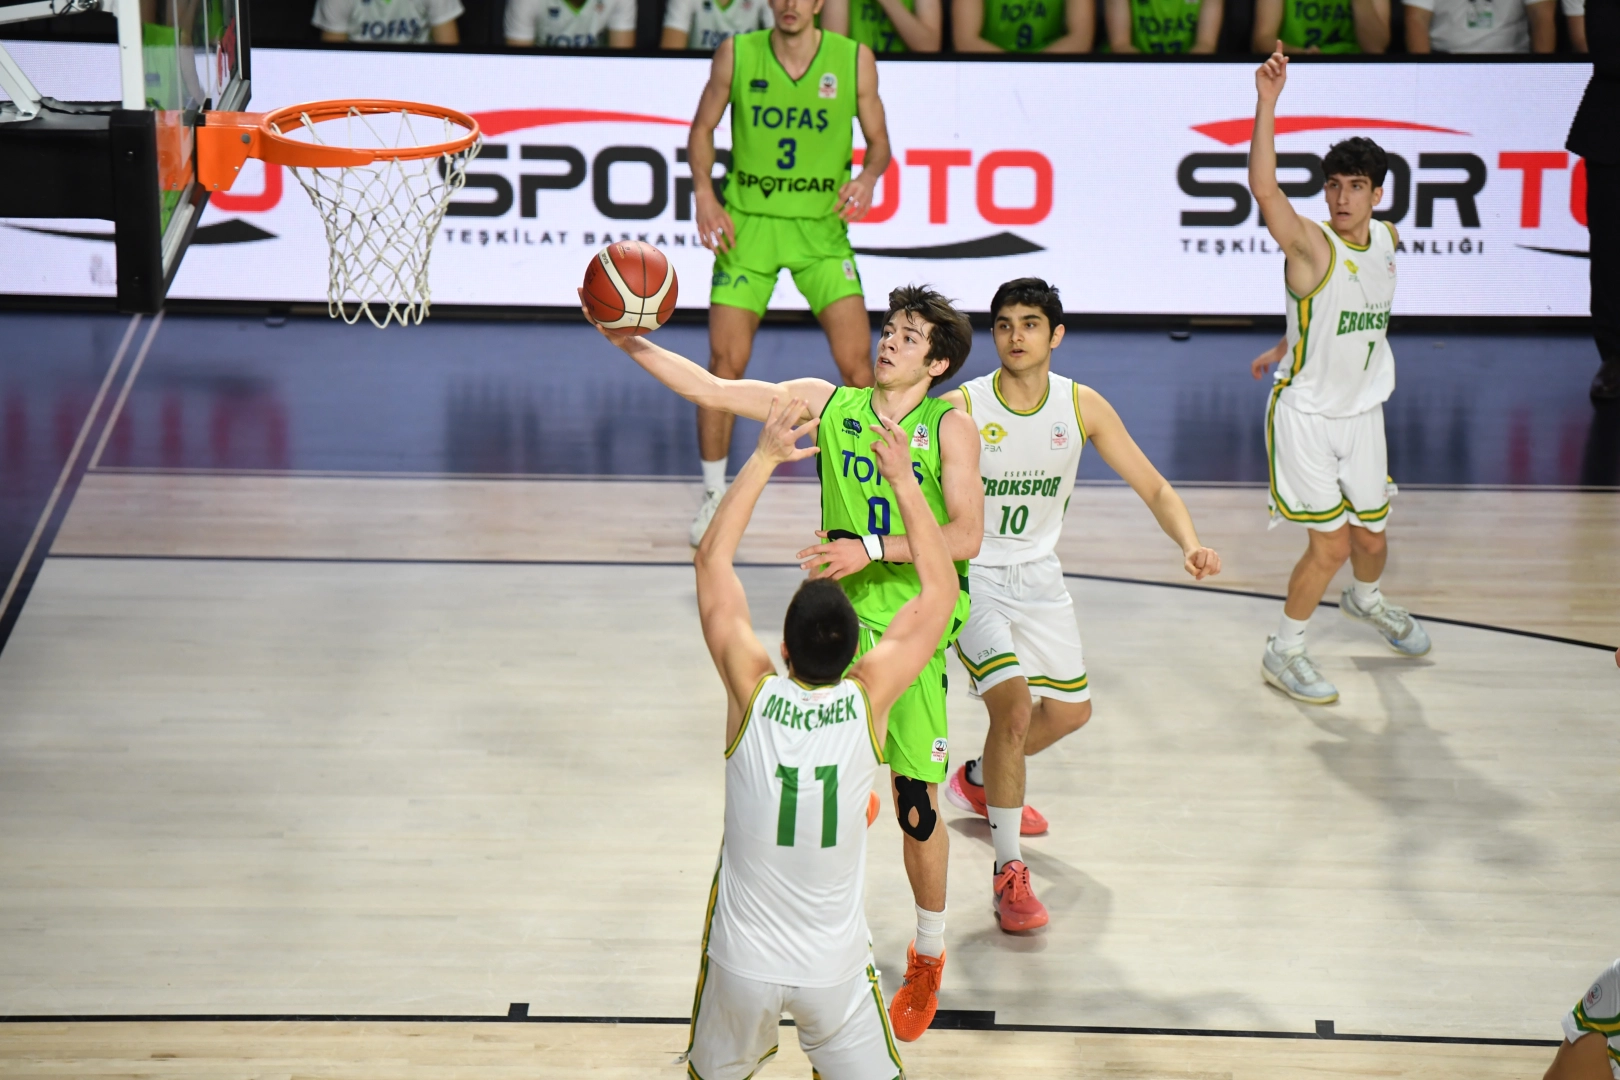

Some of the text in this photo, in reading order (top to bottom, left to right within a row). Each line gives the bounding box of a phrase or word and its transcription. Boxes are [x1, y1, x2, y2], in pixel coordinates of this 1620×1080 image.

[751, 105, 829, 132] TOFAŞ
[776, 137, 797, 170] 3
[1363, 341, 1376, 371] 1
[1004, 469, 1046, 478] ESENLER
[867, 496, 891, 536] 0
[999, 504, 1029, 535] 10
[775, 763, 839, 849] 11
